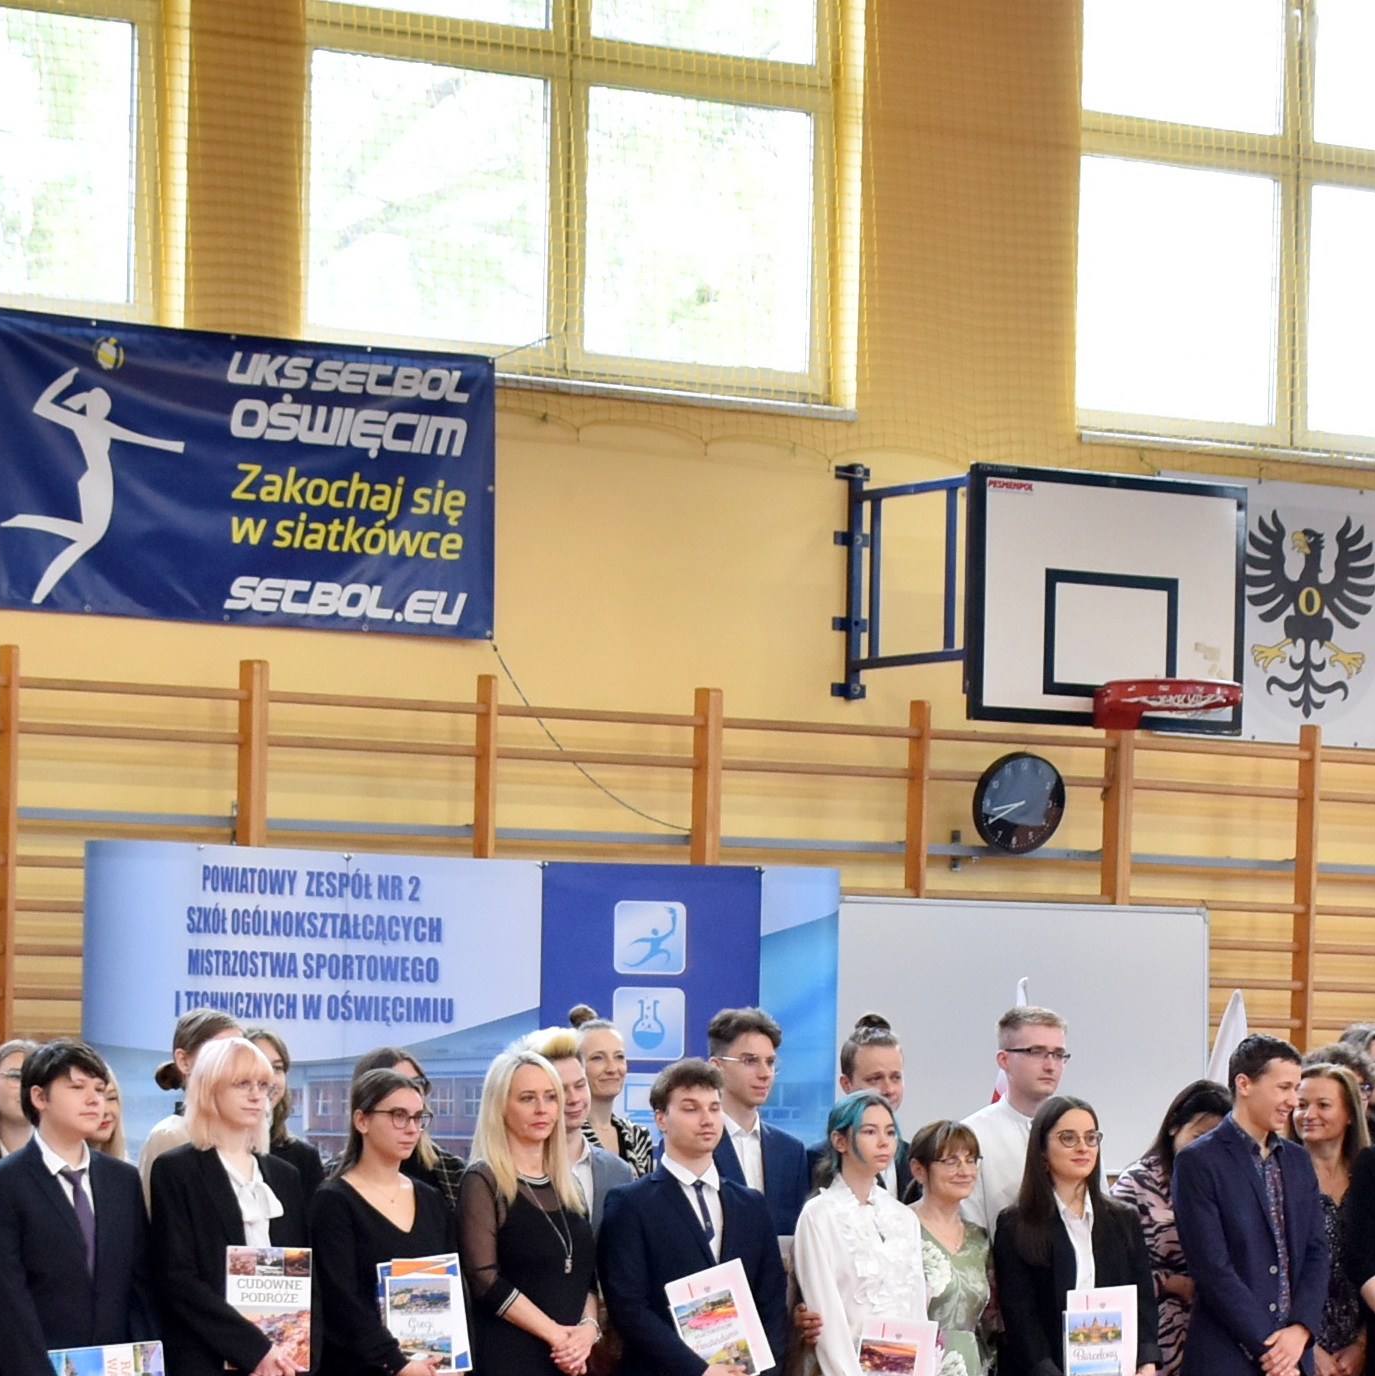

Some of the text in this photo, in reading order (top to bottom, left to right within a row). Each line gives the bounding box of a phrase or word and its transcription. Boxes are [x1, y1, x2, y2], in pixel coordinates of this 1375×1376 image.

[227, 351, 470, 403] UKS SETBOL
[230, 393, 468, 459] OŚWIĘCIM
[231, 463, 466, 526] Zakochaj się
[231, 512, 463, 560] w siatkówce
[223, 576, 468, 625] SETBOL.EU
[202, 864, 421, 902] POWIATOWY ZESPÓŁ NR 2
[186, 902, 443, 945] SZKÓŁ OGÓLNOKSZTAŁCĄCYCH
[187, 949, 440, 983] MISTRZOSTWA SPORTOWEGO
[175, 990, 181, 1018] I
[302, 993, 323, 1020] W
[326, 990, 454, 1027] OŚWIĘCIMIU
[237, 1278, 303, 1291] CUDOWNE
[240, 1291, 300, 1304] PODRÓŻE
